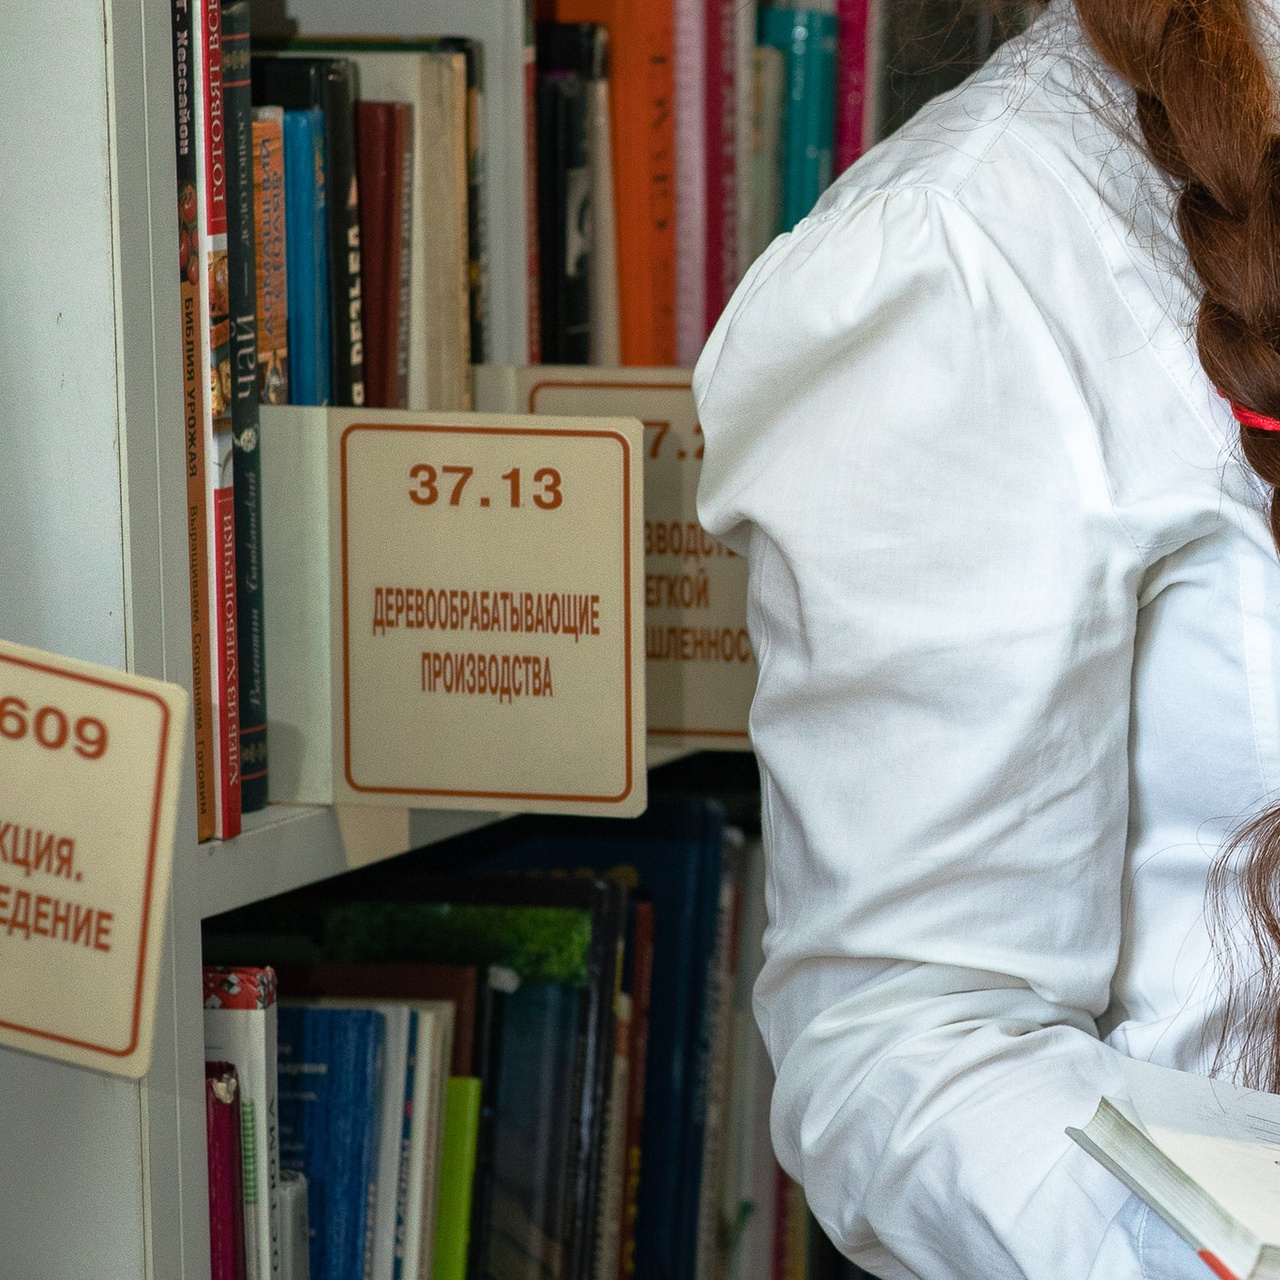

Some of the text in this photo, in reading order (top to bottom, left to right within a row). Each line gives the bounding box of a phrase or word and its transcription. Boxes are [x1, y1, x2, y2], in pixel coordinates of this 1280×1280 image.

[176, 30, 191, 156] Хессайон
[208, 57, 225, 205] ГОТОВЯТ
[184, 296, 199, 478] БИБЛИЯ УРОЖАЯ
[408, 464, 564, 510] 37.13
[372, 587, 600, 642] ДЕРЕВООБРАБАТЫВАЮЩИЕ
[645, 626, 757, 662] ШЛЕННОС
[222, 513, 238, 787] ХЛЕБ ИЗ ХЛЕБОПЕЧКИ
[421, 651, 553, 704] ПРОИЗВОДСТВА
[0, 696, 109, 760] 609
